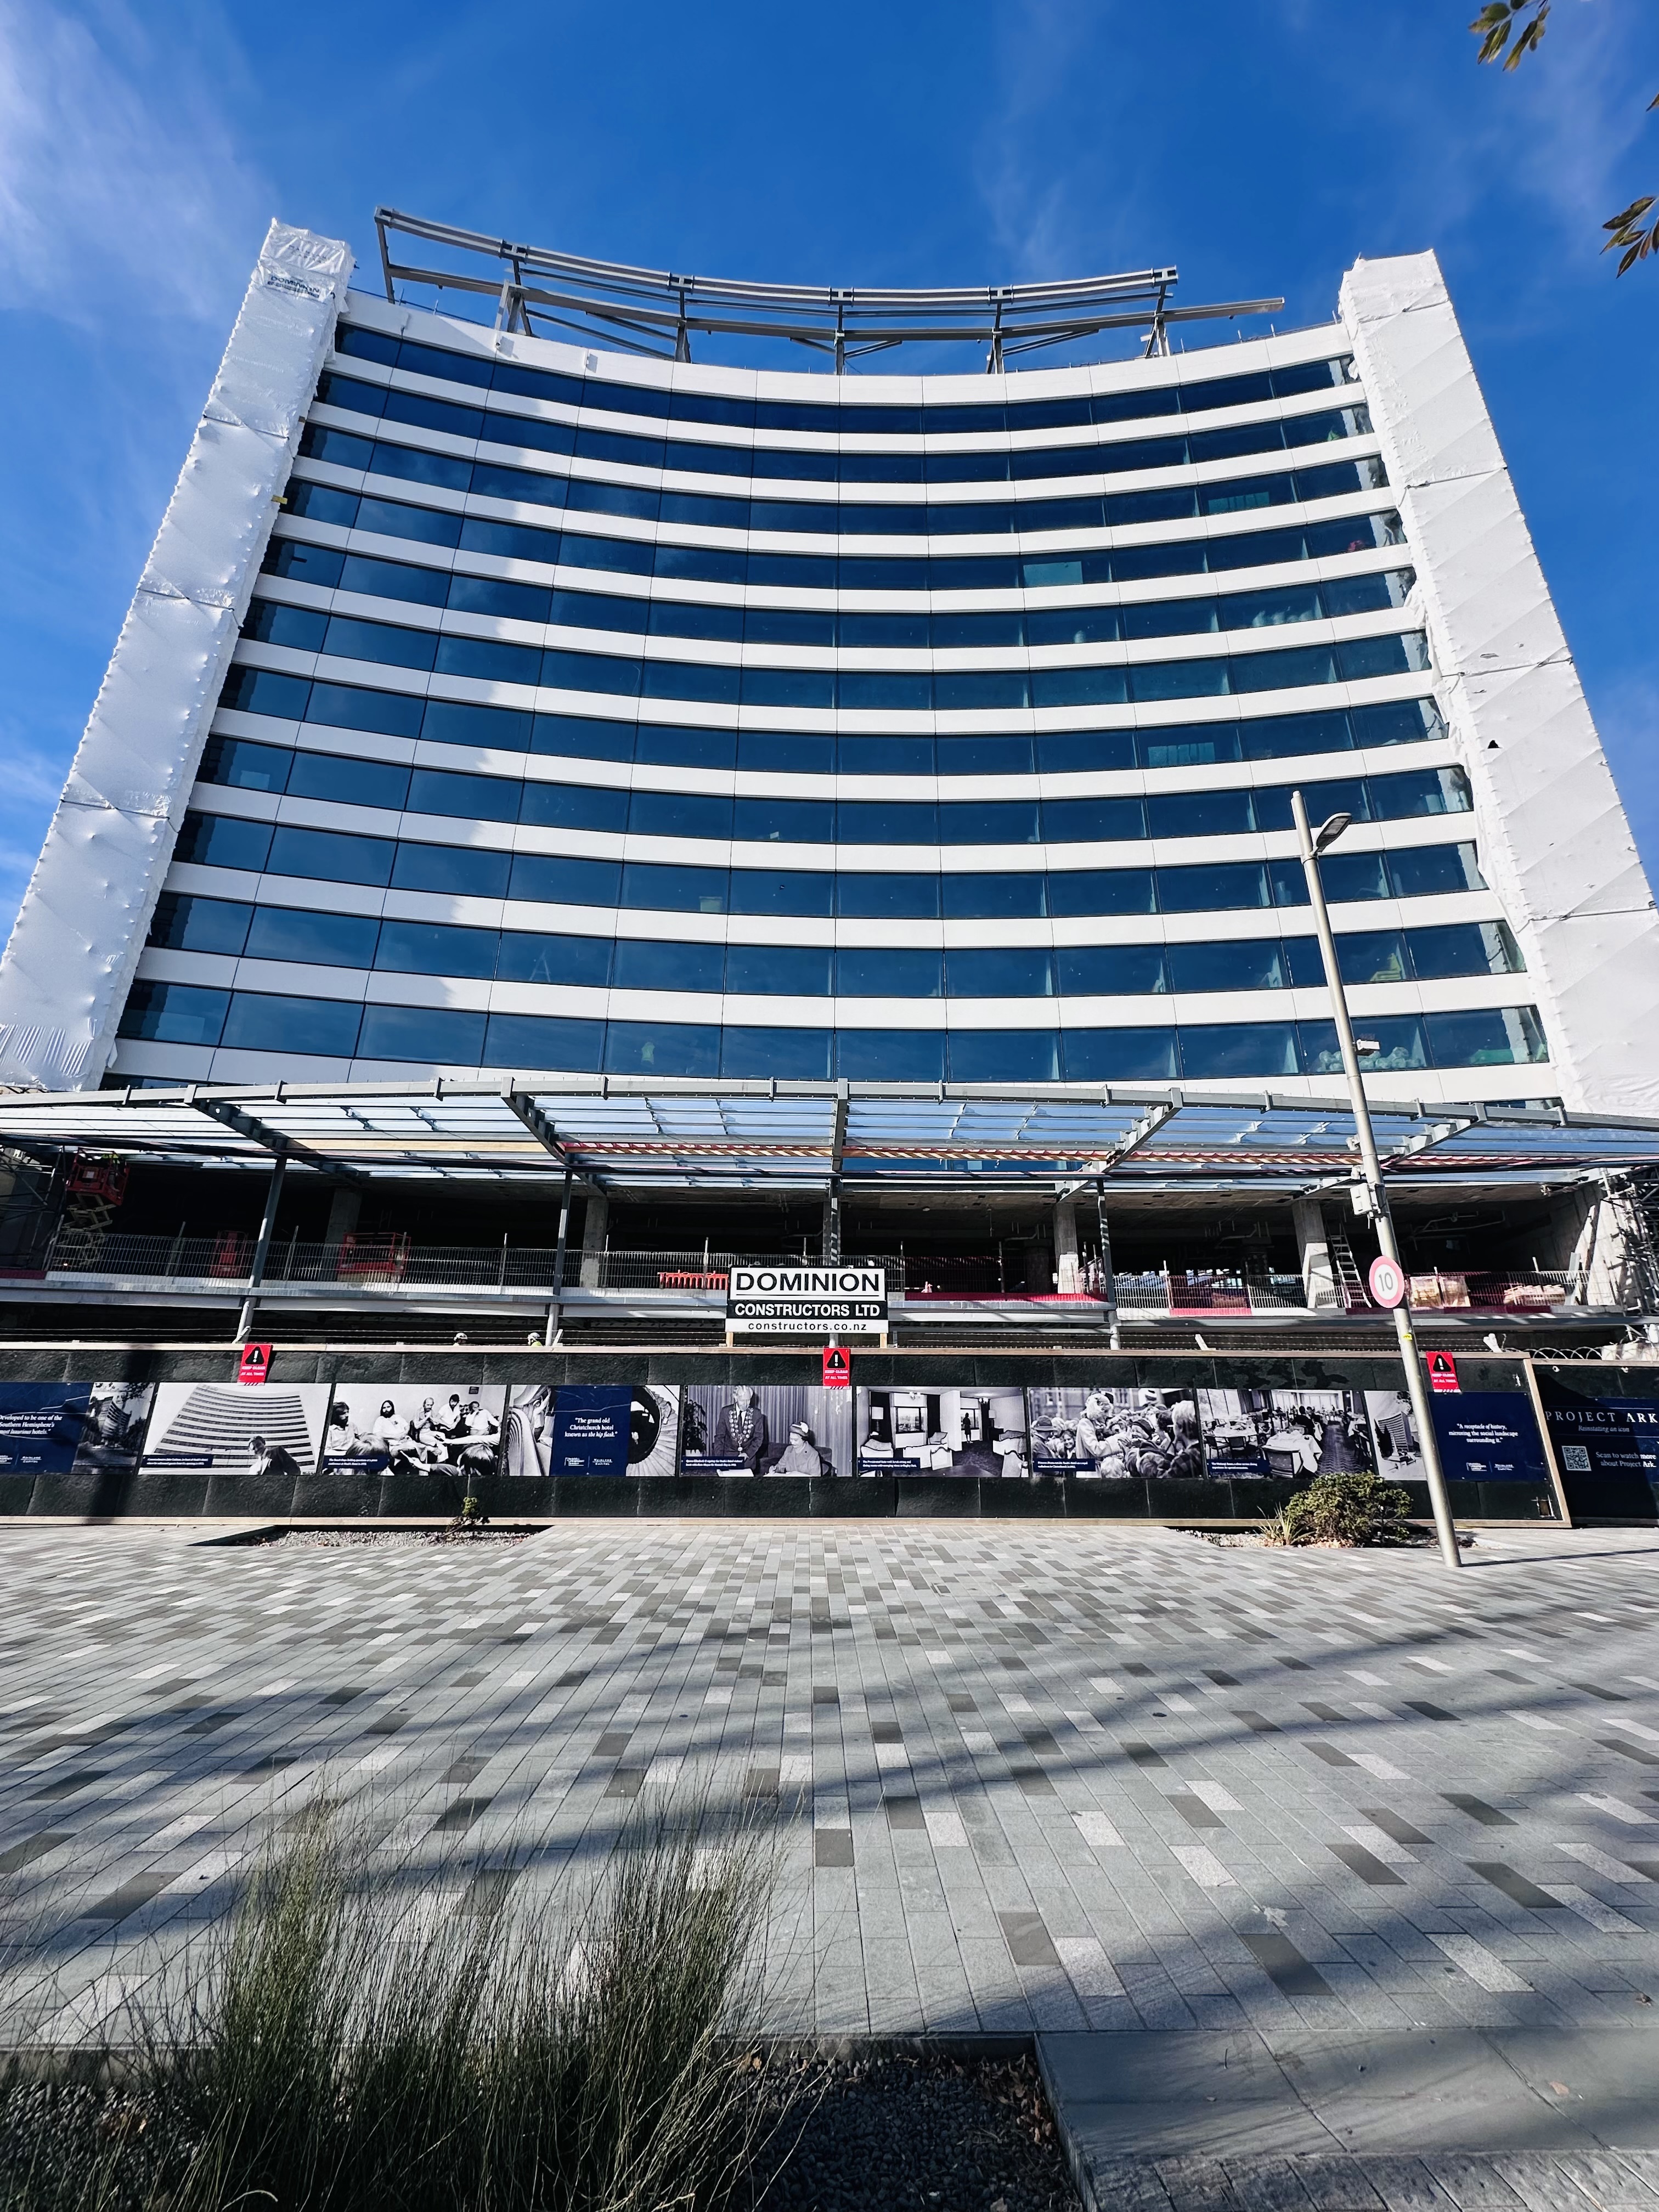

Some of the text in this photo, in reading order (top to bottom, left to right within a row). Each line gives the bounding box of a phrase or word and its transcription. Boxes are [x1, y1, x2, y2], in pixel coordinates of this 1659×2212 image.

[736, 1273, 879, 1291] DOMINION
[1379, 1272, 1393, 1291] 10
[735, 1303, 880, 1317] CONSTRUCTORS LTD
[748, 1321, 867, 1331] constructors.co.nz
[1544, 1411, 1658, 1423] PROJECT ARK
